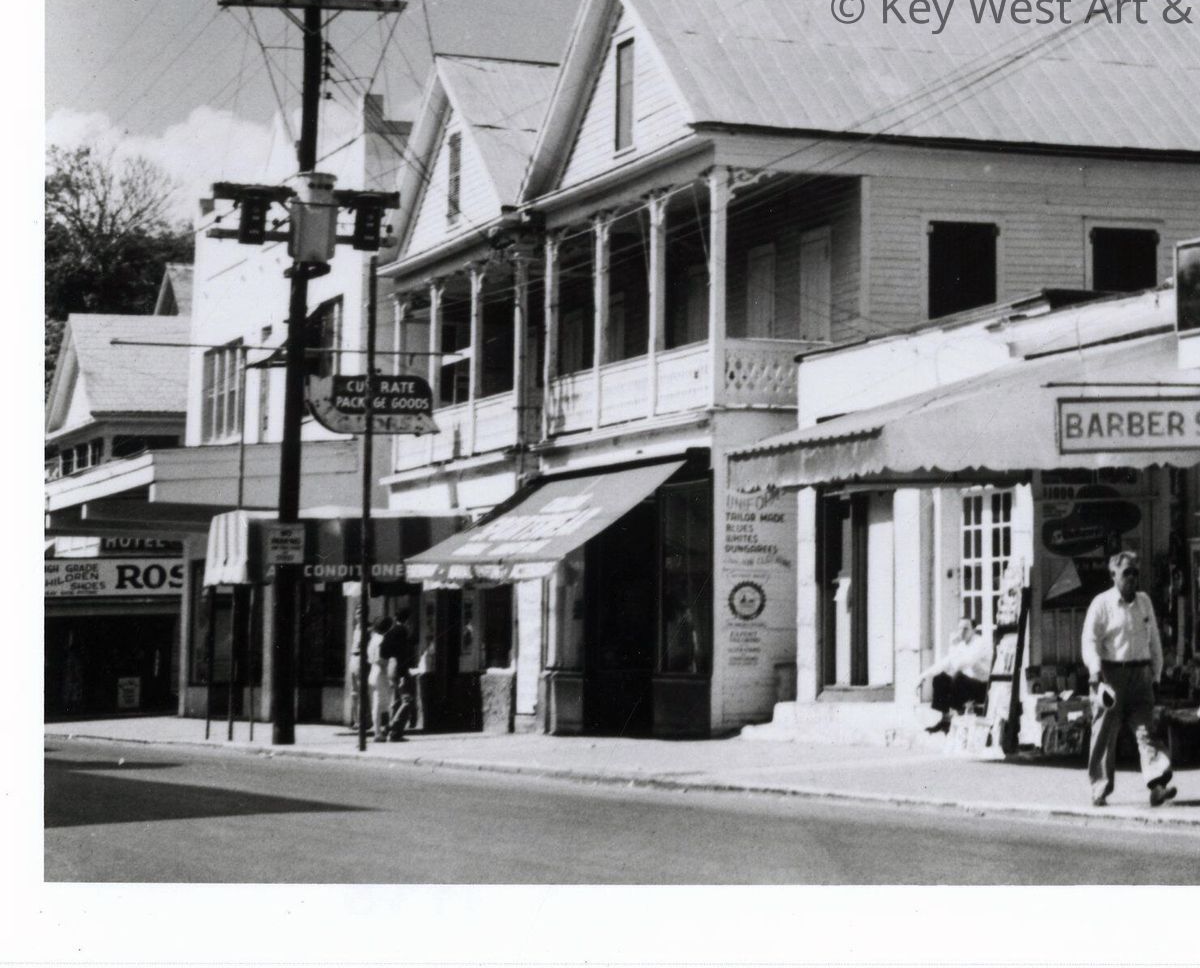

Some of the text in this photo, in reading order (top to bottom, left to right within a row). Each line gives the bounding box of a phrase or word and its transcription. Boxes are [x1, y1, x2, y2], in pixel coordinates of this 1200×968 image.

[346, 380, 415, 393] CU RATE
[336, 395, 430, 409] PACKGE GOODS
[1066, 412, 1185, 439] BARBER
[65, 563, 99, 573] GRADE
[70, 582, 106, 590] SHOES
